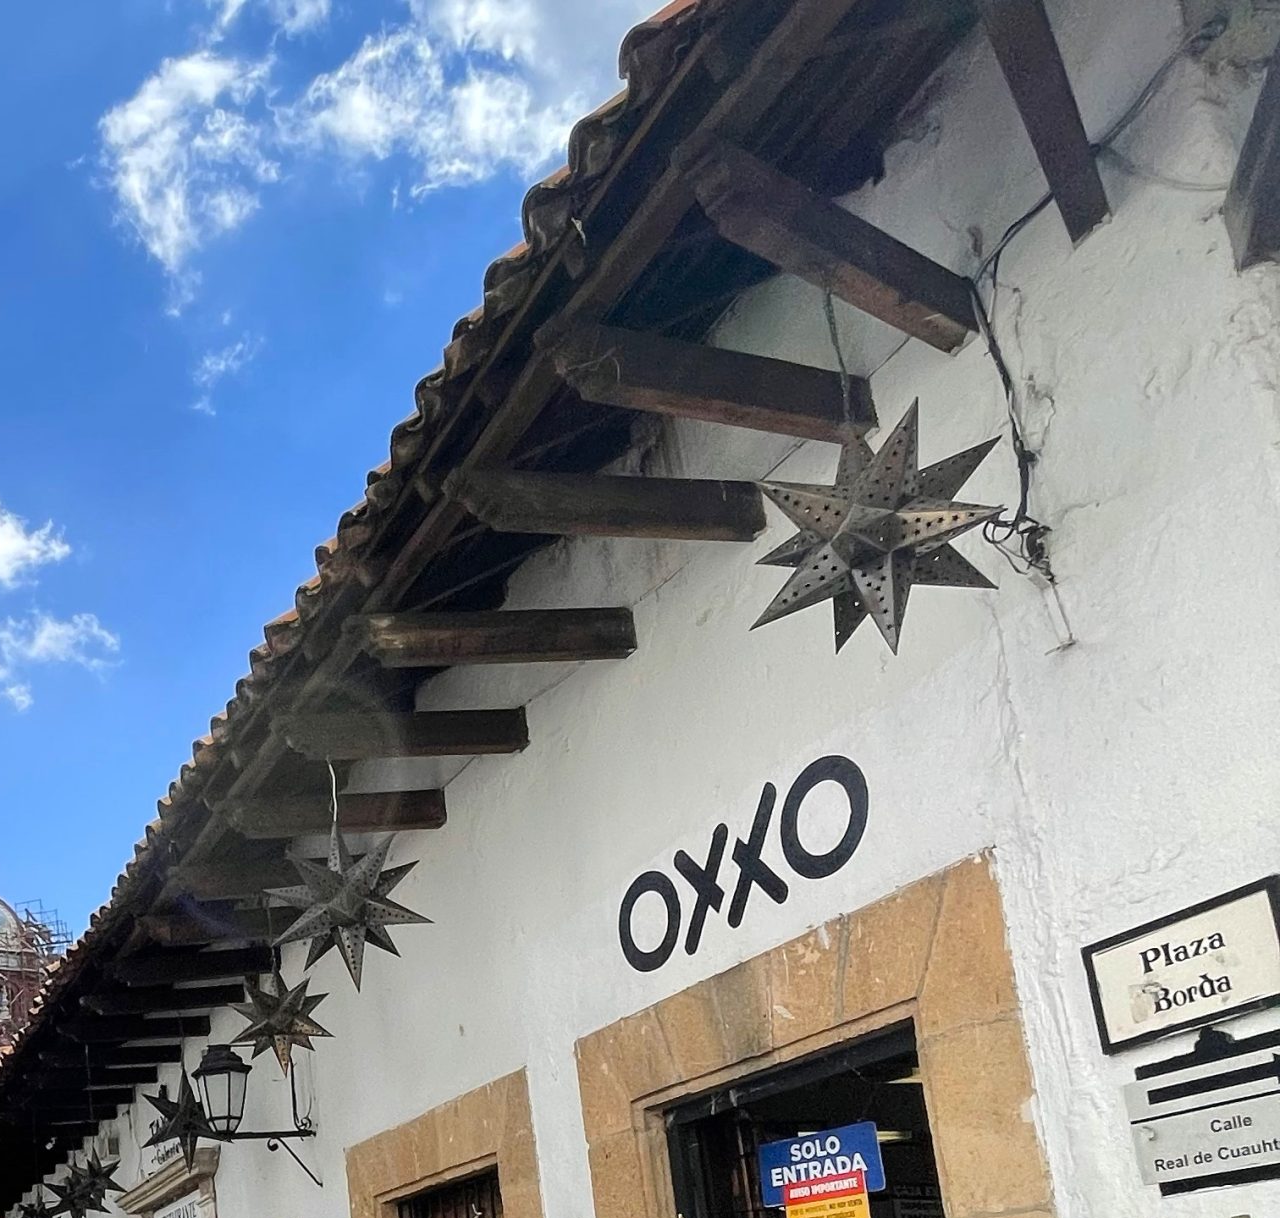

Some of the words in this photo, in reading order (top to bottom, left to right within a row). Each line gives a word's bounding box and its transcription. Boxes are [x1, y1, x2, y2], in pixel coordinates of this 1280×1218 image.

[619, 755, 869, 972] OXXO
[1139, 931, 1226, 974] Plaza
[1153, 973, 1232, 1014] Borda
[1210, 1115, 1253, 1133] Calle
[790, 1135, 840, 1162] SOLO
[1154, 1154, 1189, 1172] Real
[1193, 1151, 1213, 1165] de
[770, 1152, 868, 1187] ENTRADA
[811, 1177, 859, 1195] IMPORTANTE
